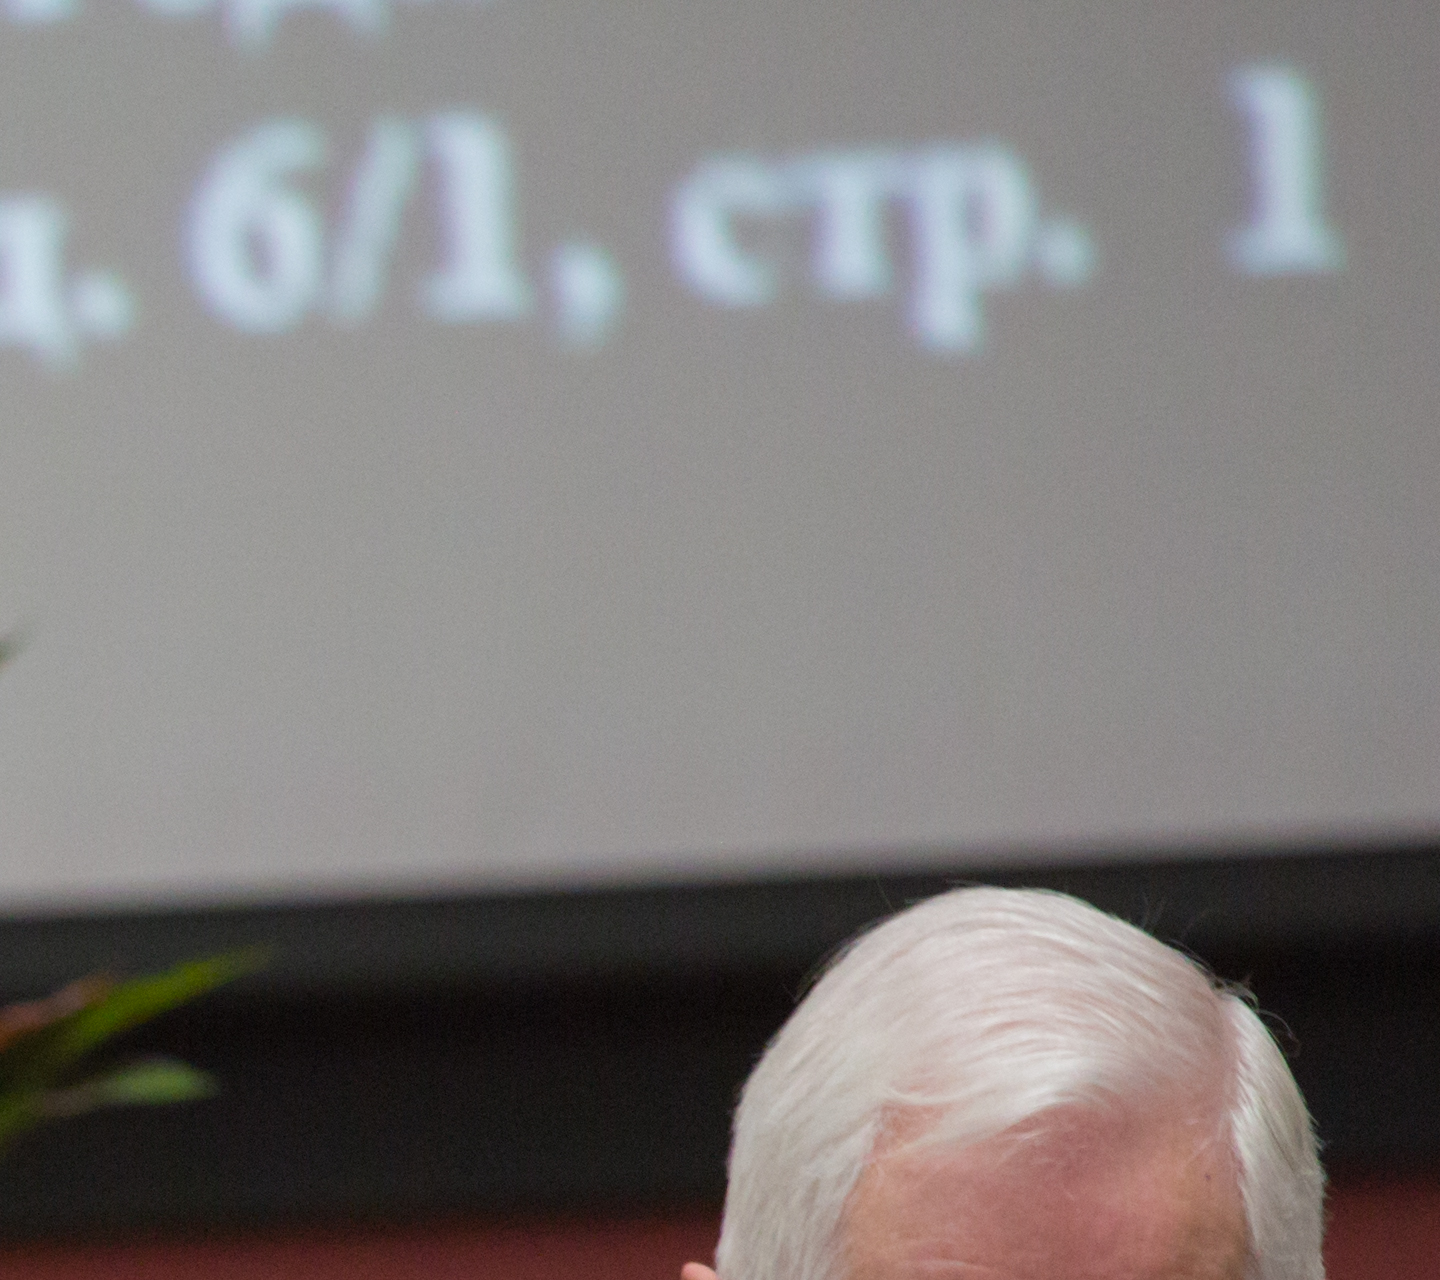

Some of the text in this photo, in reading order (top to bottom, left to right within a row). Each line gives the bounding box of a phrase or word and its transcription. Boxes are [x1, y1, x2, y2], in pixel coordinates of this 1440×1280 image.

[183, 110, 620, 342] 6/1,
[670, 140, 1090, 352] стр.
[1228, 64, 1340, 272] 1
